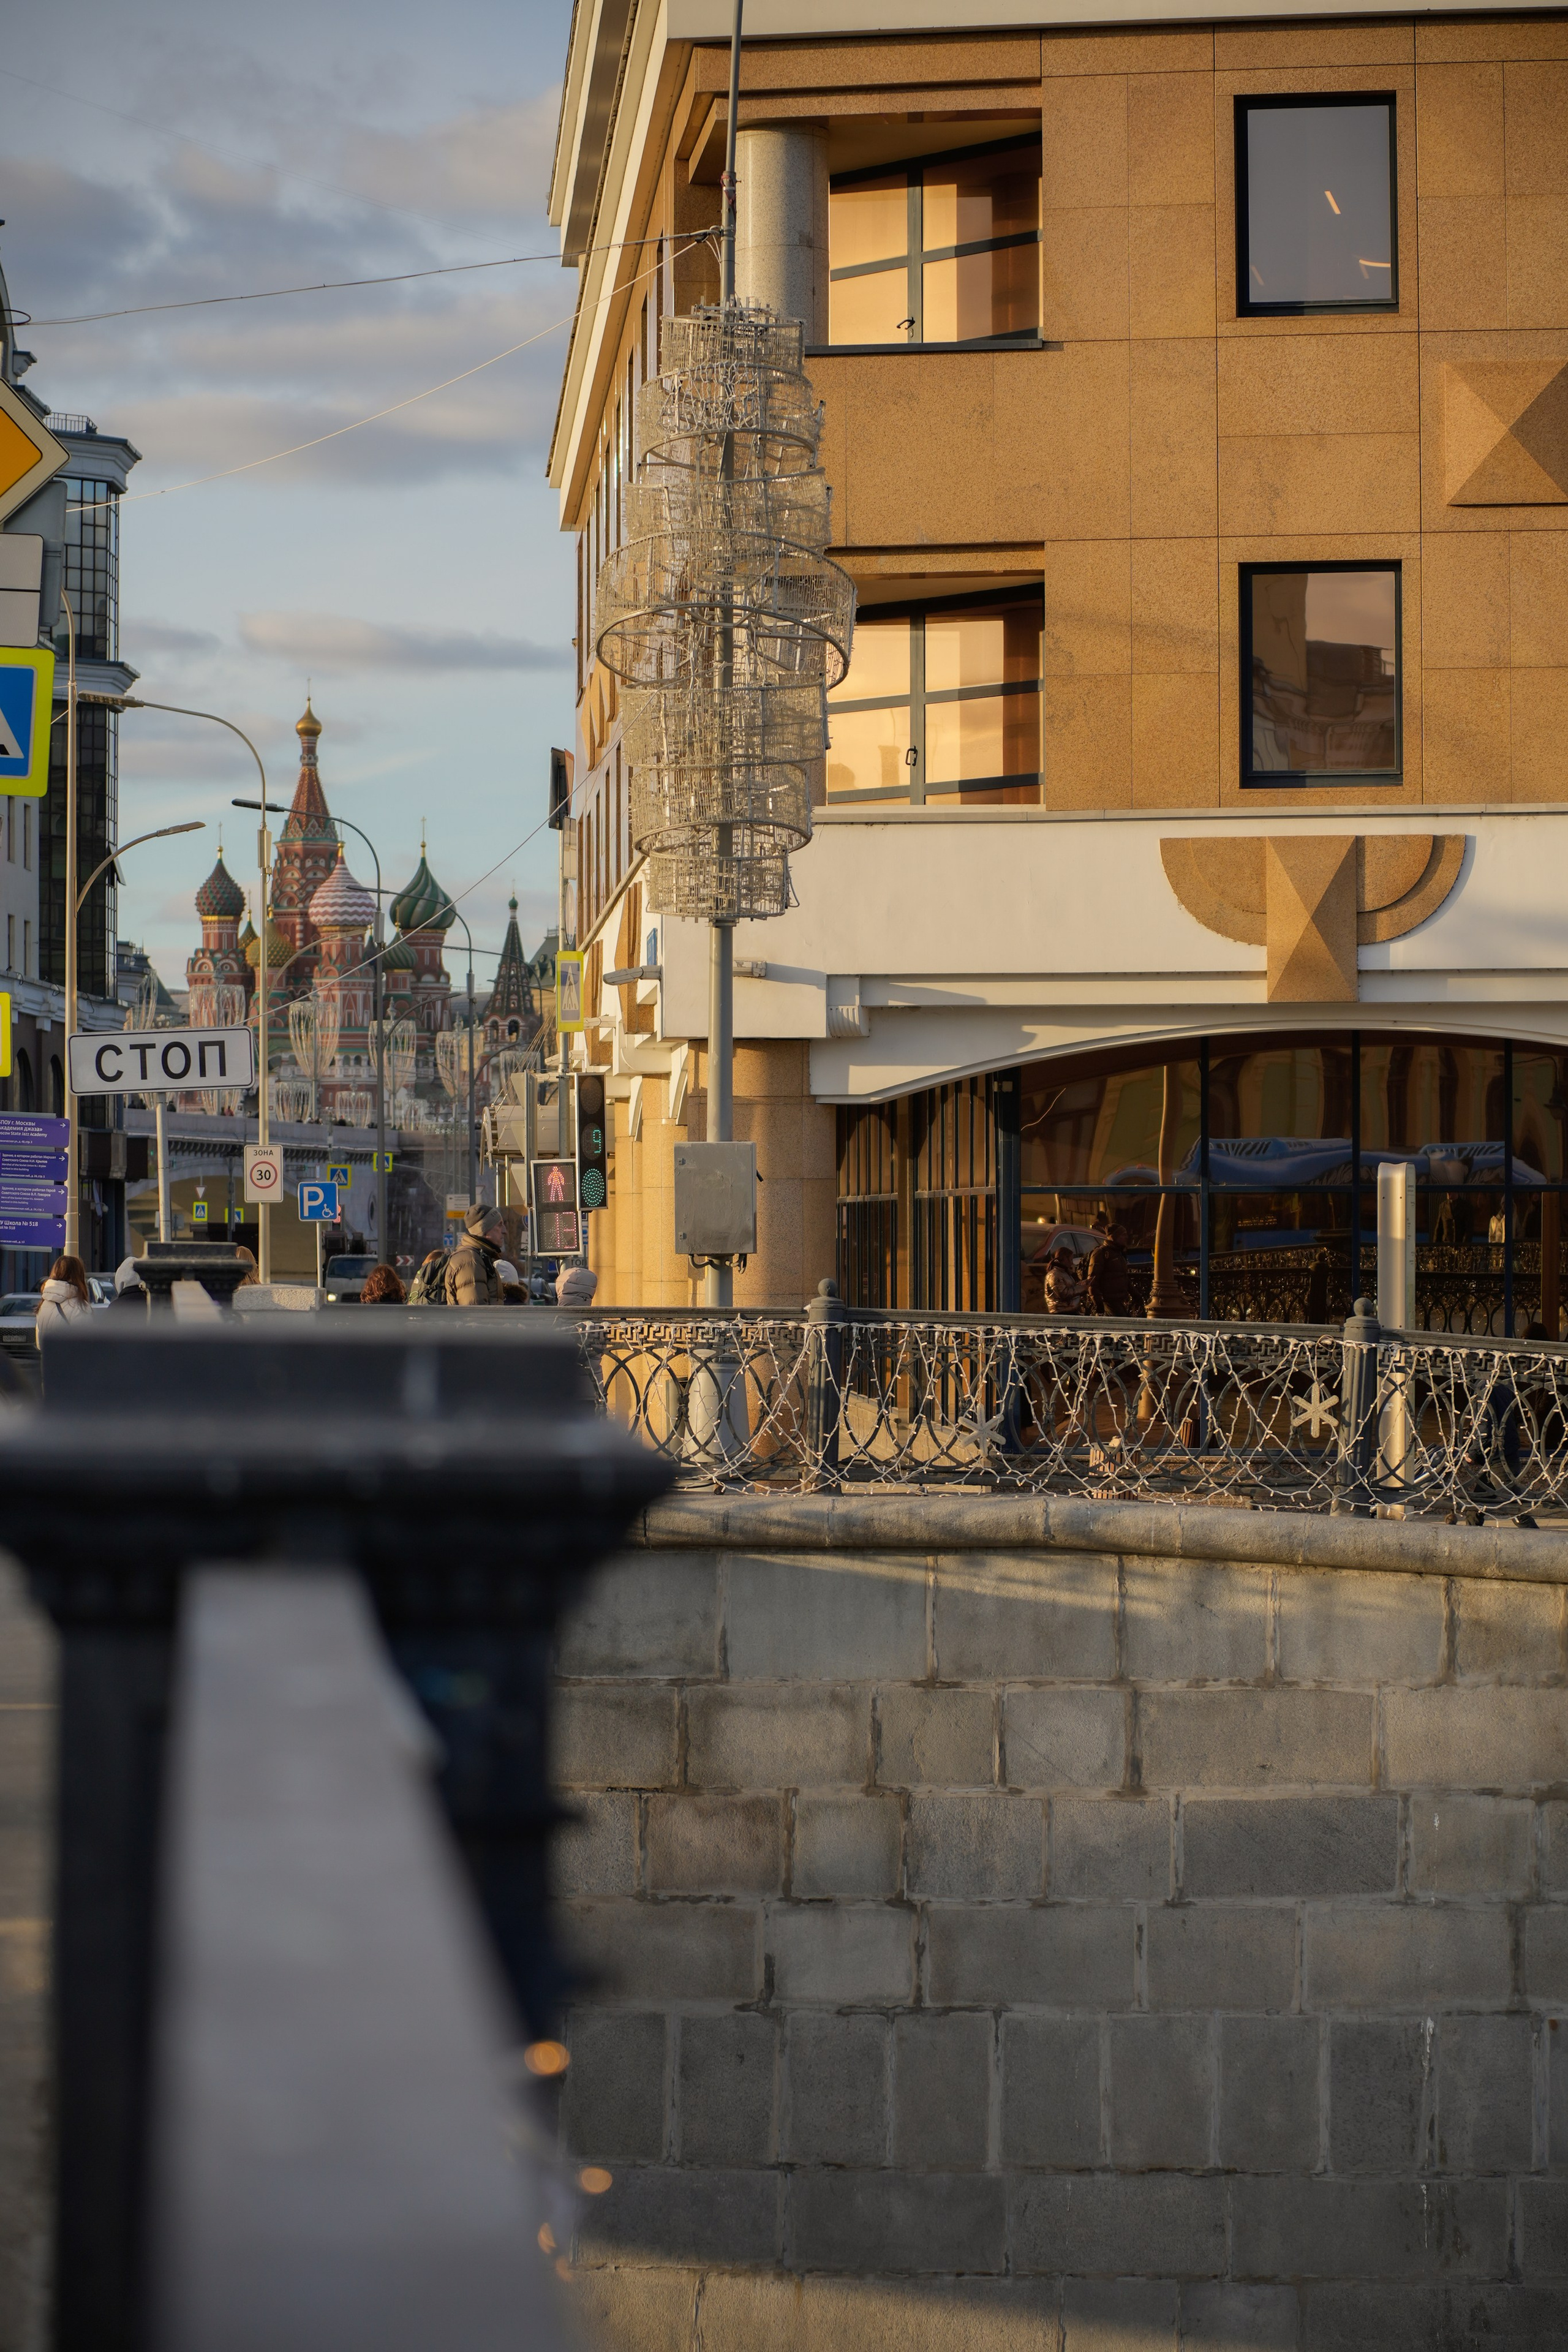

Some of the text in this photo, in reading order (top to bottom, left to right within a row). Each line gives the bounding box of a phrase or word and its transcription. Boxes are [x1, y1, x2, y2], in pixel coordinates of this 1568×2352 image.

[95, 1039, 226, 1082] СТОП
[593, 1129, 601, 1153] 9
[257, 1170, 271, 1180] 30
[303, 1186, 324, 1216] P
